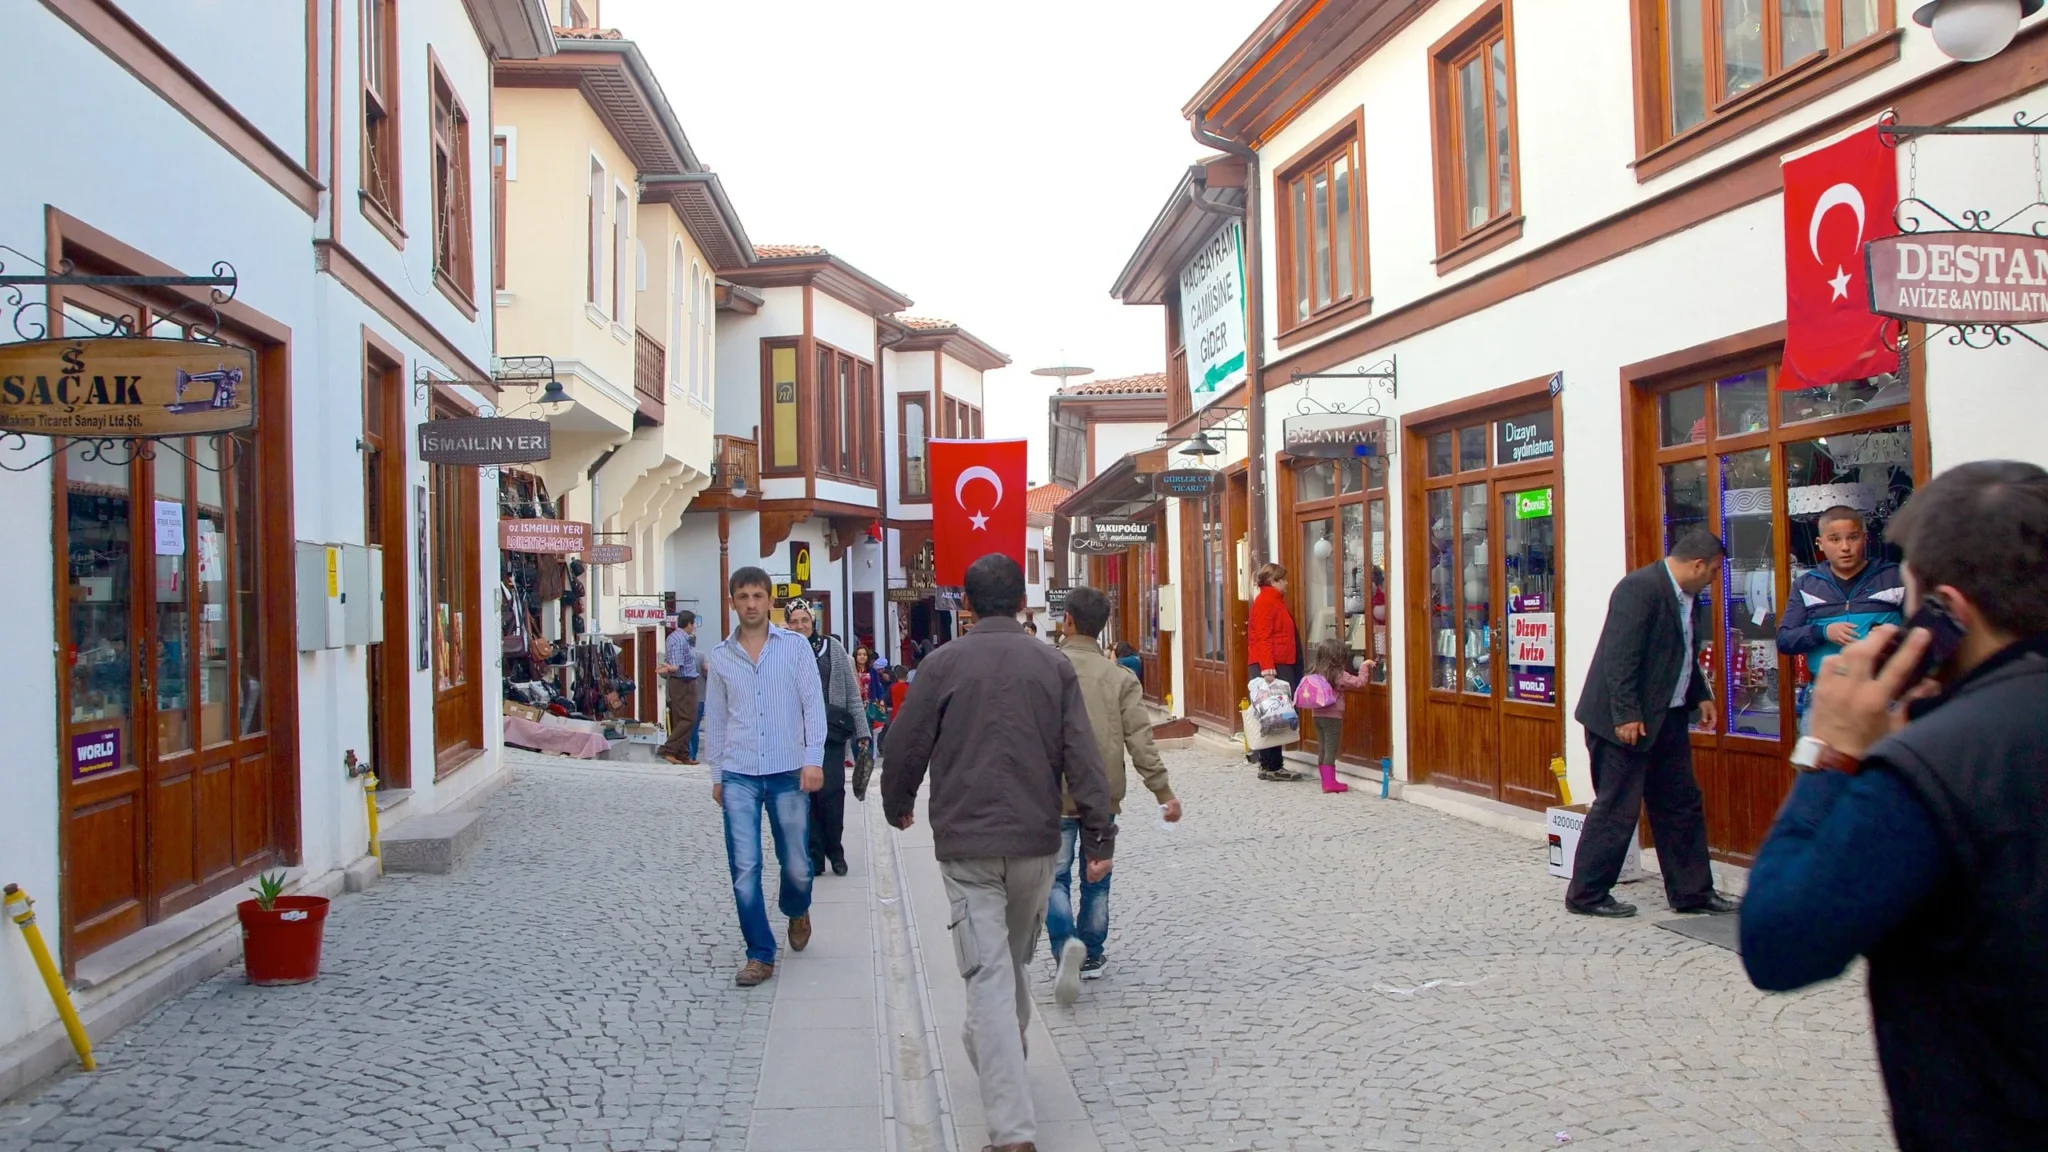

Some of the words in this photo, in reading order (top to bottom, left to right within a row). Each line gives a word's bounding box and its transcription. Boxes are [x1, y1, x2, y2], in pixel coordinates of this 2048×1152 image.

[1182, 222, 1236, 294] HACIBAYRAM
[1190, 271, 1234, 331] CAMİİSİNE
[1200, 321, 1228, 364] GİDER
[3, 375, 142, 413] SAÇAK
[1, 414, 36, 427] Makina
[38, 414, 72, 427] Ticaret
[75, 414, 107, 430] Sanayi
[109, 414, 143, 430] Ltd.Şti.
[1505, 422, 1537, 442] Dizayn
[1512, 439, 1554, 462] aydınlatma
[1163, 474, 1196, 483] GÜRLER
[1197, 474, 1214, 483] CAM
[1172, 483, 1207, 492] TİCARET
[1095, 522, 1148, 533] YAKUPOĞLU
[1515, 617, 1547, 642] Dizayn
[1519, 642, 1545, 662] Avize
[1519, 680, 1545, 692] WORLD
[77, 741, 114, 762] WORLD
